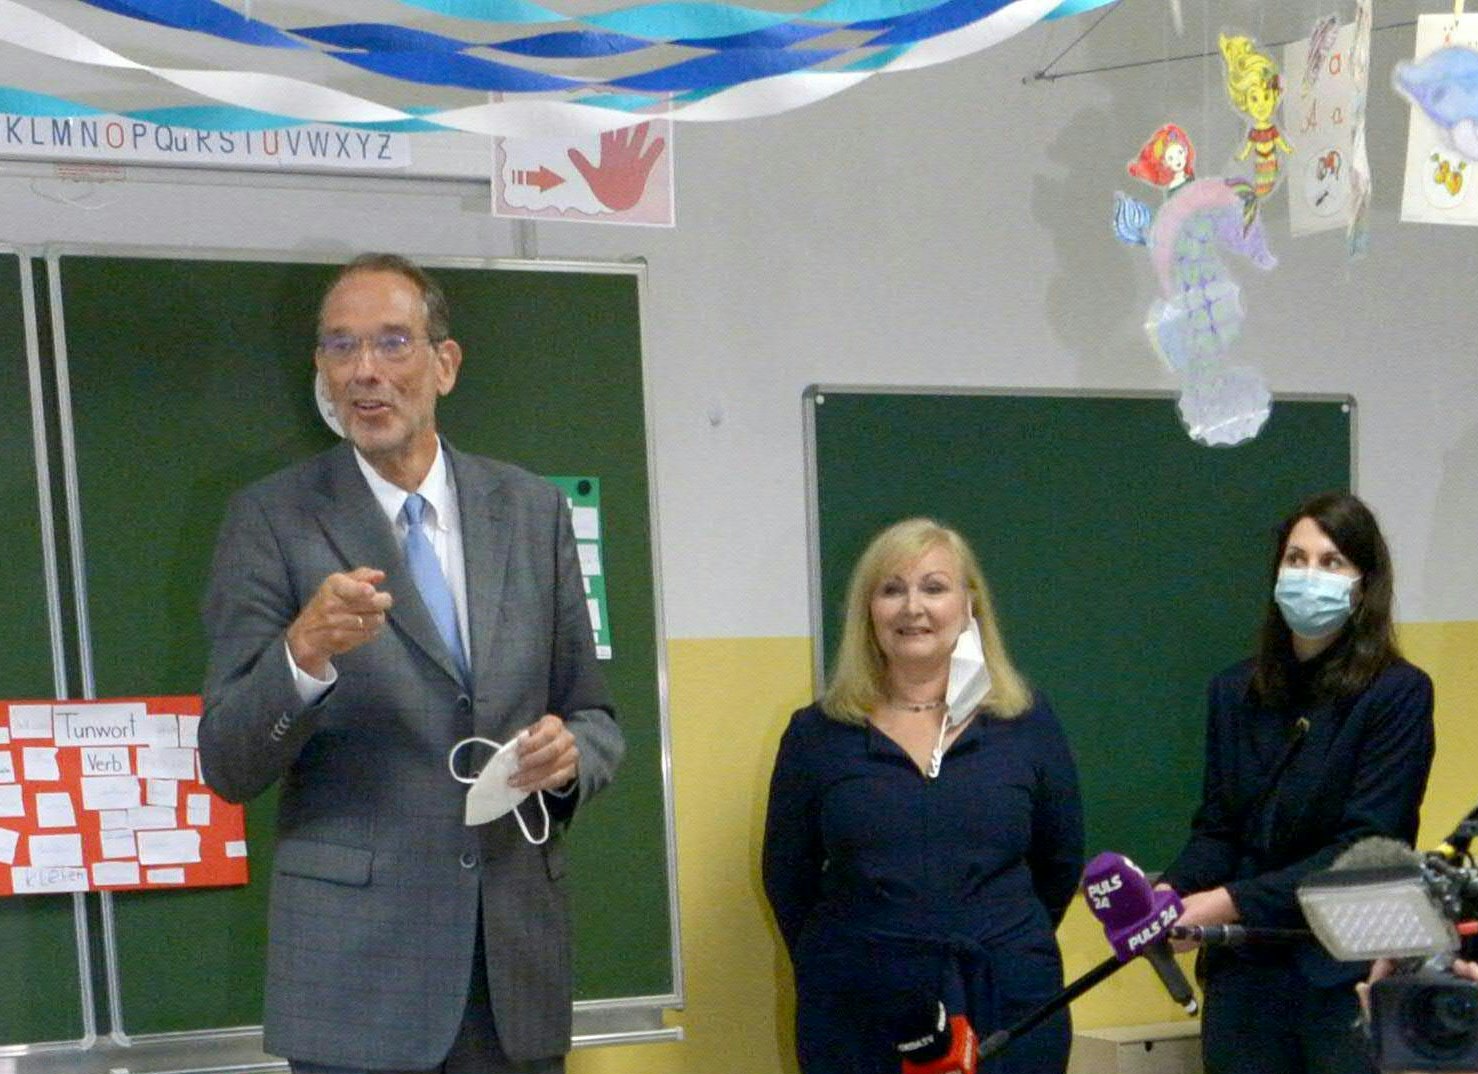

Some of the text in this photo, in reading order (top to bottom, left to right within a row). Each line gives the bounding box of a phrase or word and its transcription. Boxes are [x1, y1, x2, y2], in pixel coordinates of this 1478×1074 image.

[55, 712, 136, 740] Tunwort
[86, 753, 123, 773] Verb
[1087, 874, 1123, 899] PULS
[1093, 895, 1112, 910] 24
[1127, 904, 1178, 951] PULS 24
